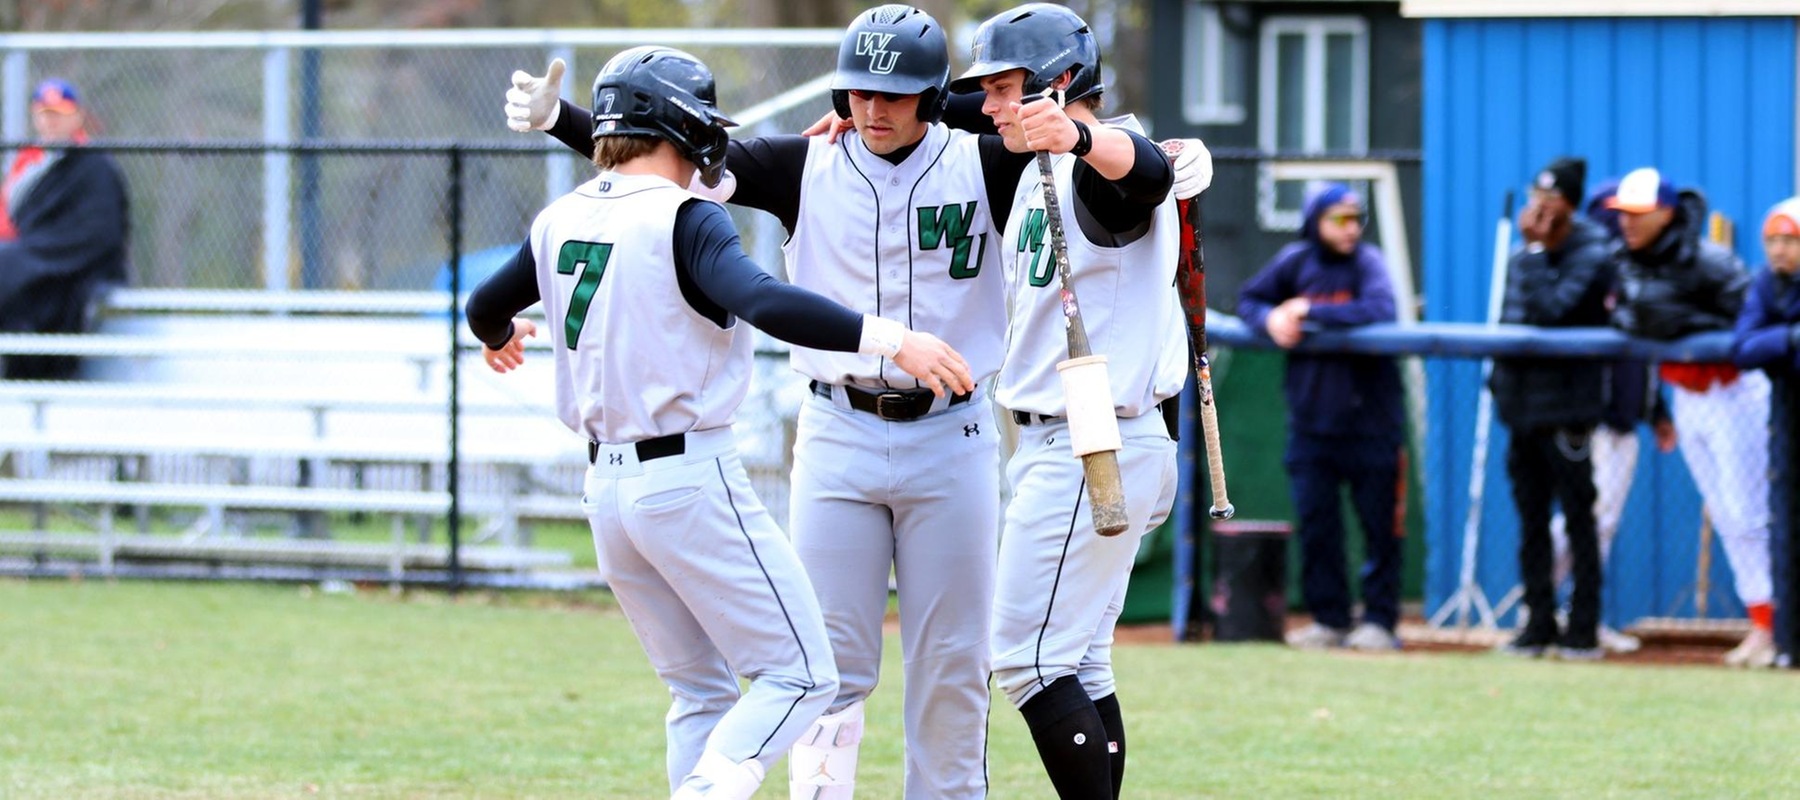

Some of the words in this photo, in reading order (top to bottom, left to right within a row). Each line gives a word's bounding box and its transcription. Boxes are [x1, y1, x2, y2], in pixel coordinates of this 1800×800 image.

[855, 32, 902, 75] WU
[605, 93, 615, 114] 7
[916, 200, 988, 280] WU
[1018, 208, 1057, 288] WU
[556, 239, 614, 351] 7
